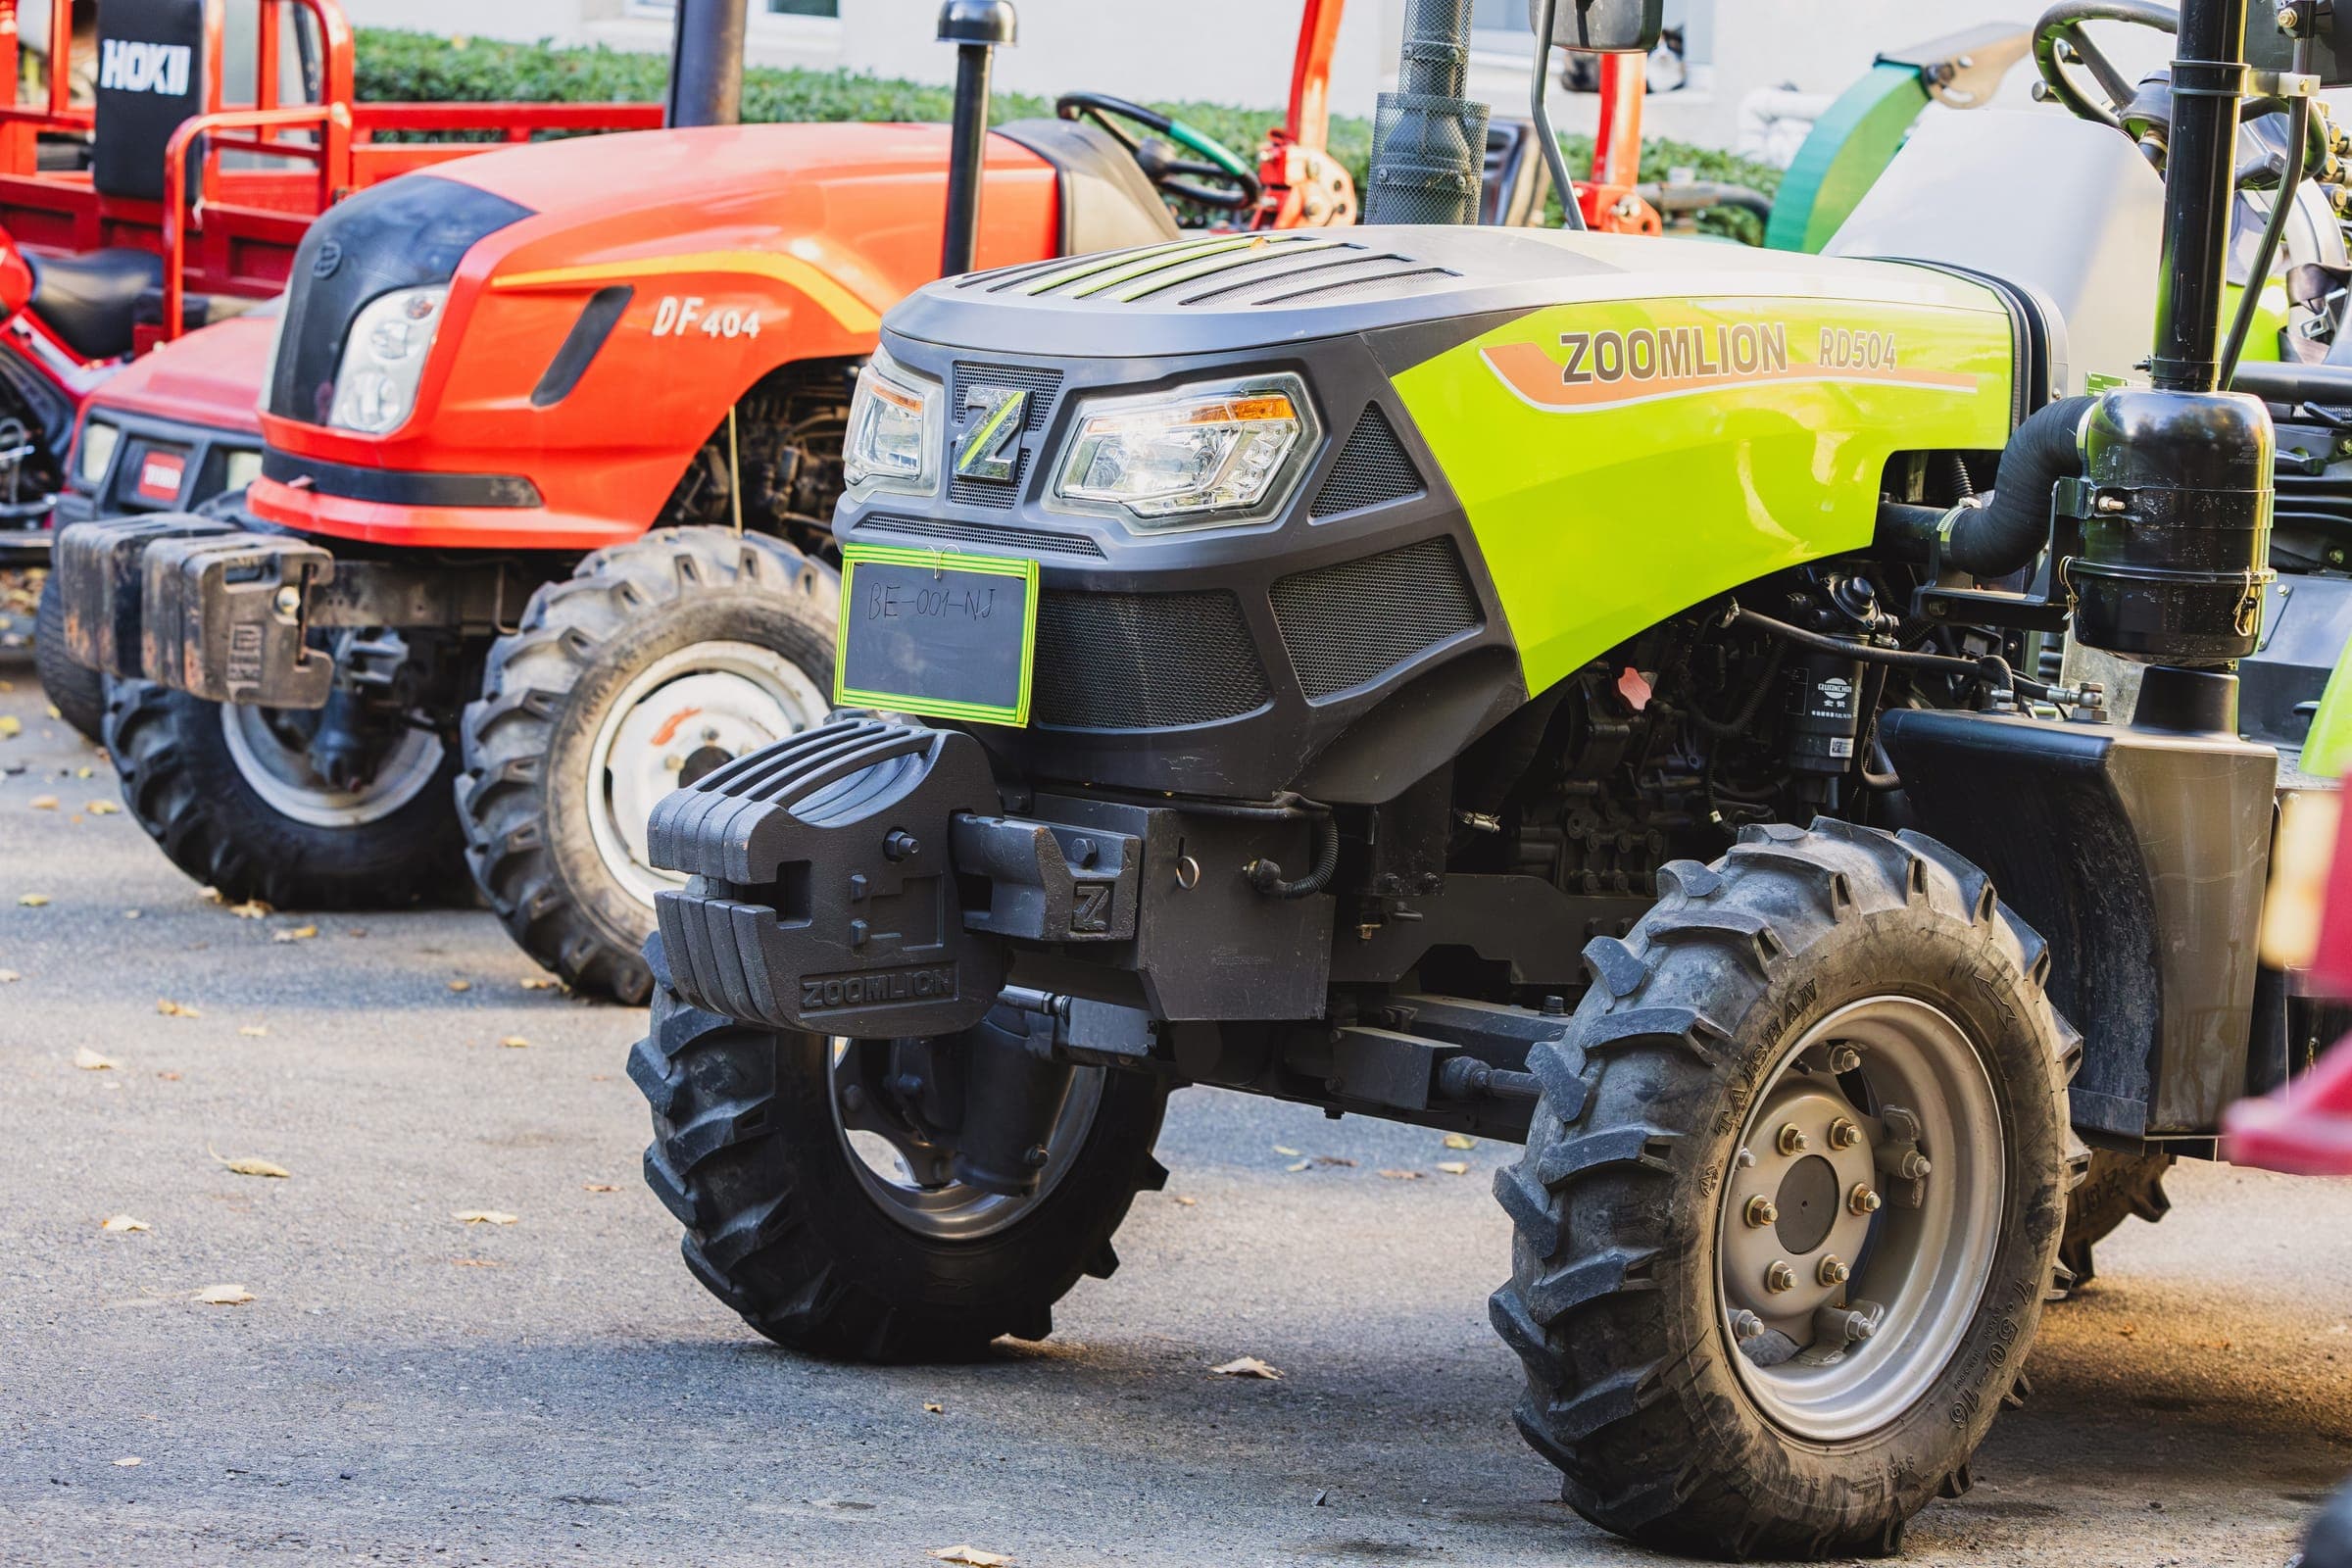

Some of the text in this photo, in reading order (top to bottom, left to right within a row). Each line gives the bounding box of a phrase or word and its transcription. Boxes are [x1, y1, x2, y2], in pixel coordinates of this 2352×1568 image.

[651, 296, 761, 339] DF 404
[1559, 321, 1896, 385] ZOOMLION RD504
[867, 582, 997, 622] BE-001-NJ
[802, 968, 956, 1009] ZOOMLION
